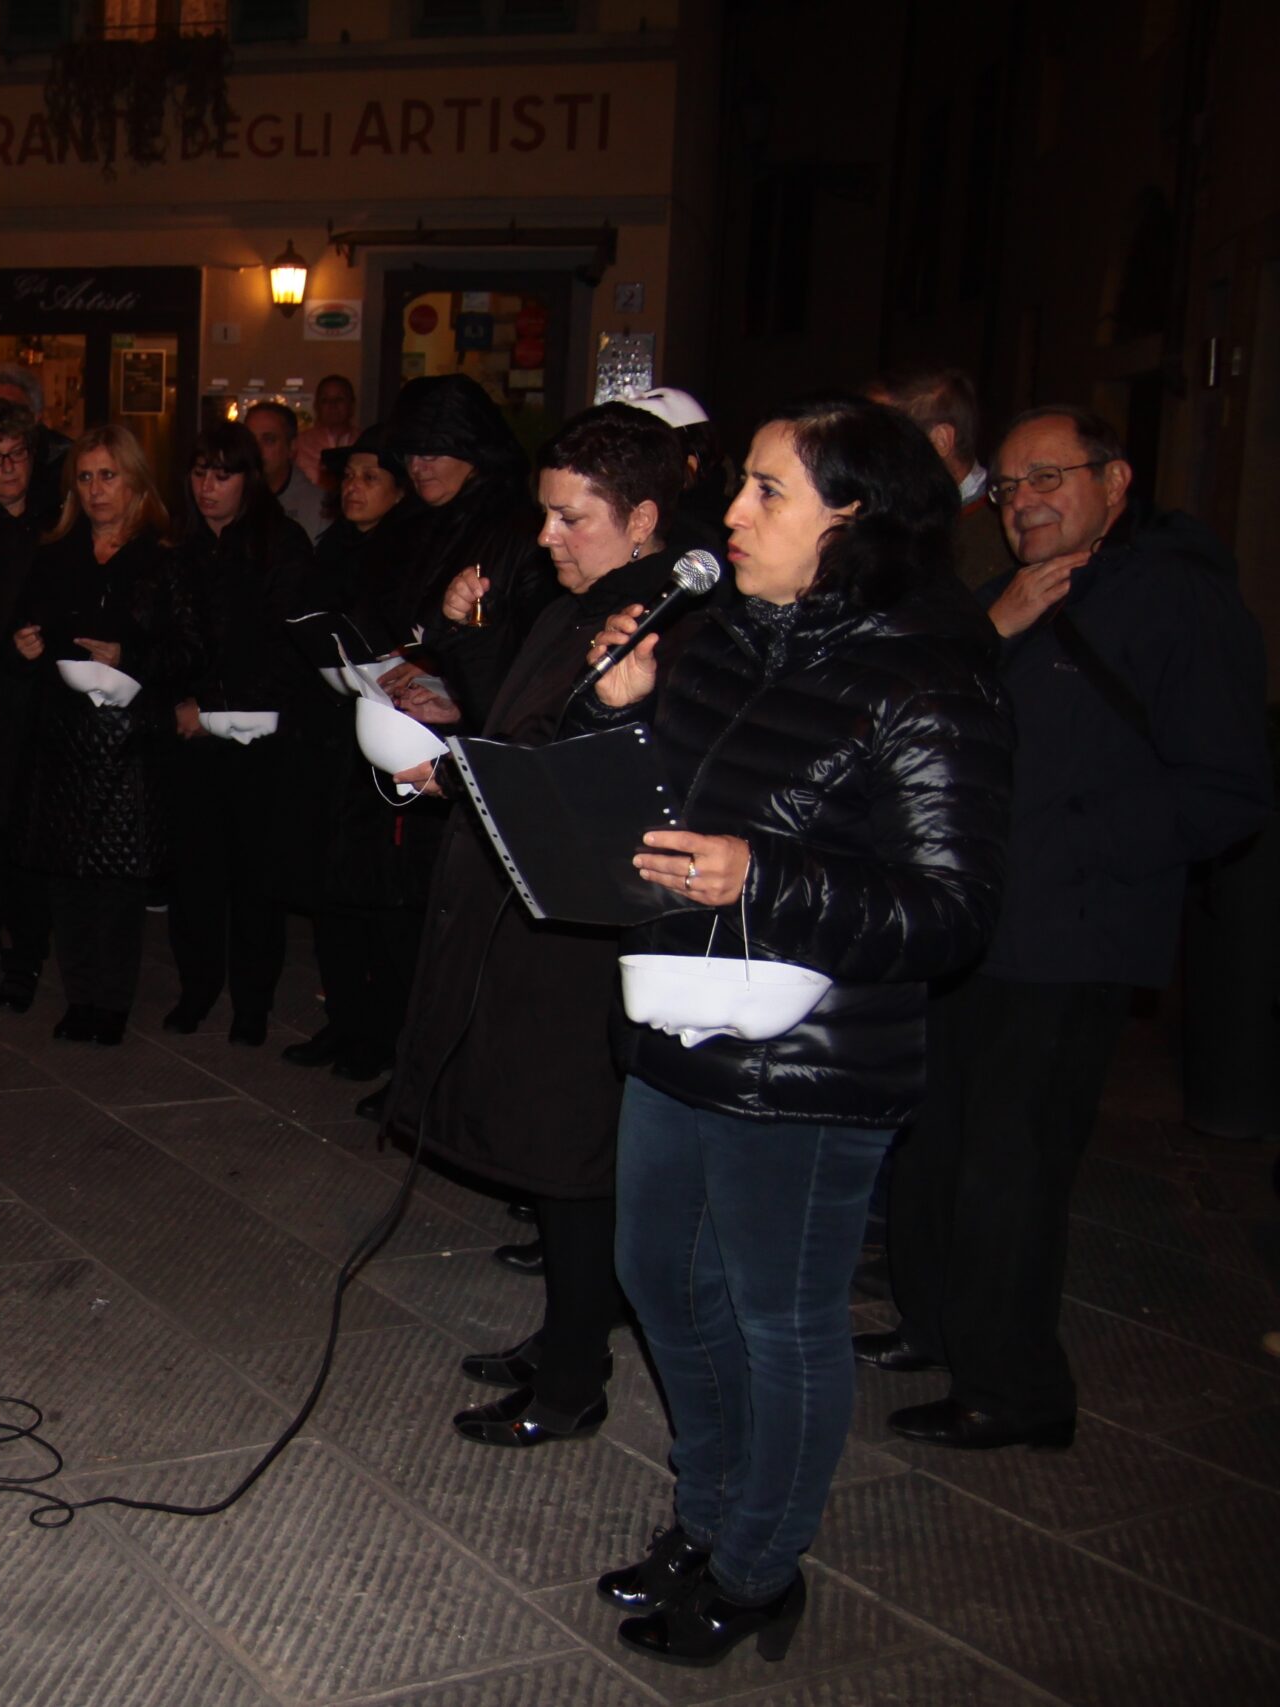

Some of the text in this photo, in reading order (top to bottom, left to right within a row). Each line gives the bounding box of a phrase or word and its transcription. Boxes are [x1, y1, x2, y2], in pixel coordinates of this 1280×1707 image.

[180, 111, 332, 161] DEGLI
[349, 93, 612, 156] ARTISTI
[39, 276, 142, 311] Artisti
[622, 287, 635, 307] 2
